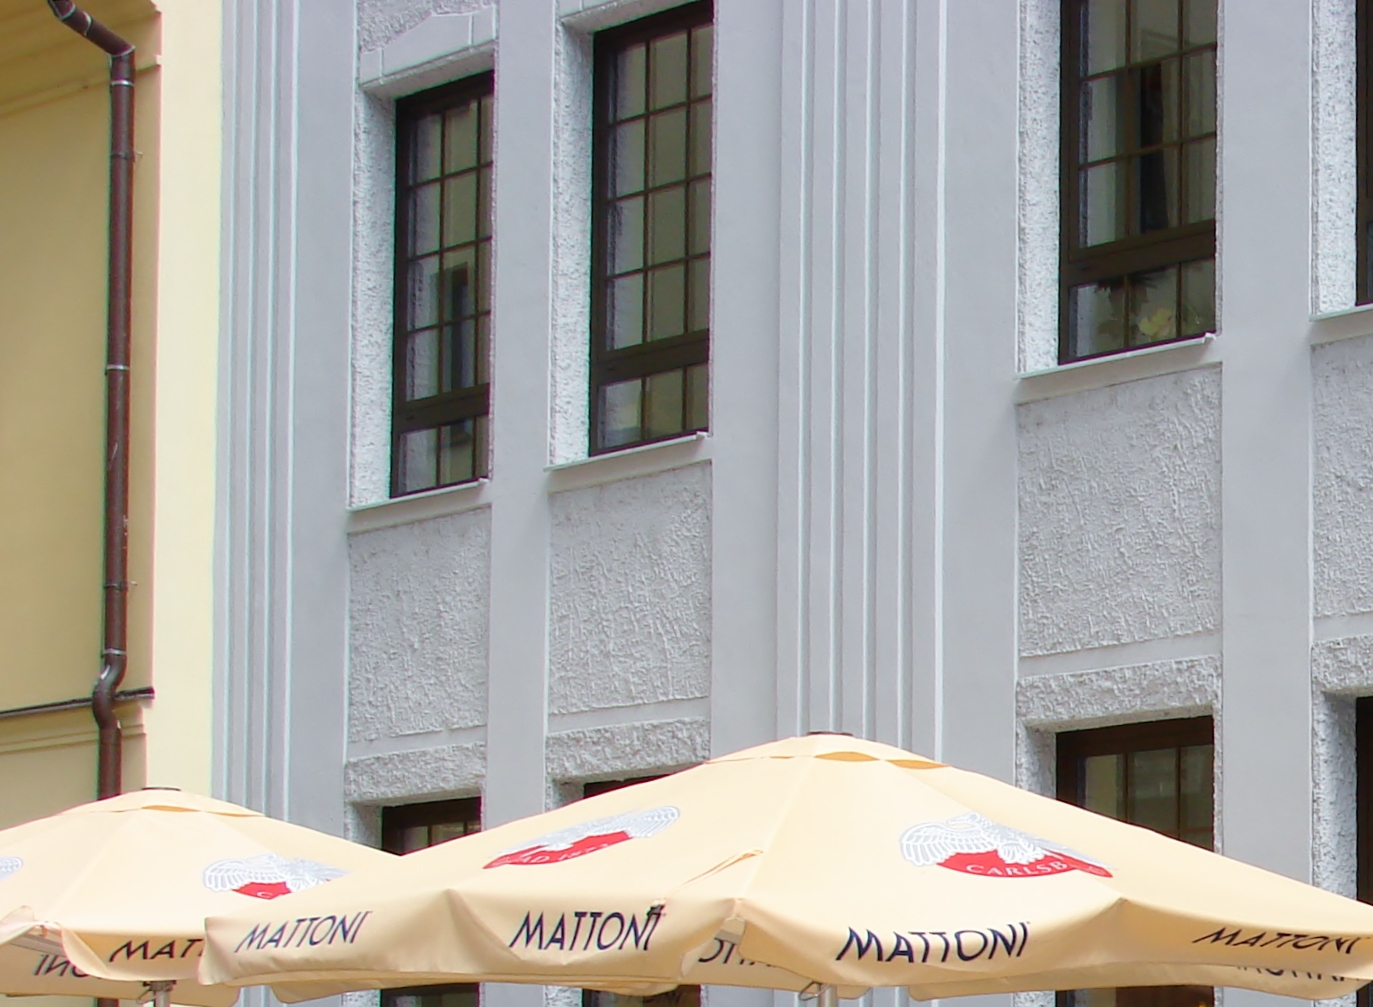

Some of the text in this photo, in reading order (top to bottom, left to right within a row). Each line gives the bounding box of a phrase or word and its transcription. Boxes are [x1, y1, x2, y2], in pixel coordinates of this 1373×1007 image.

[234, 911, 371, 953] MATTONI
[508, 911, 663, 951] MATTONI
[835, 922, 1029, 963] MATTONI
[1191, 927, 1361, 954] MATTONI
